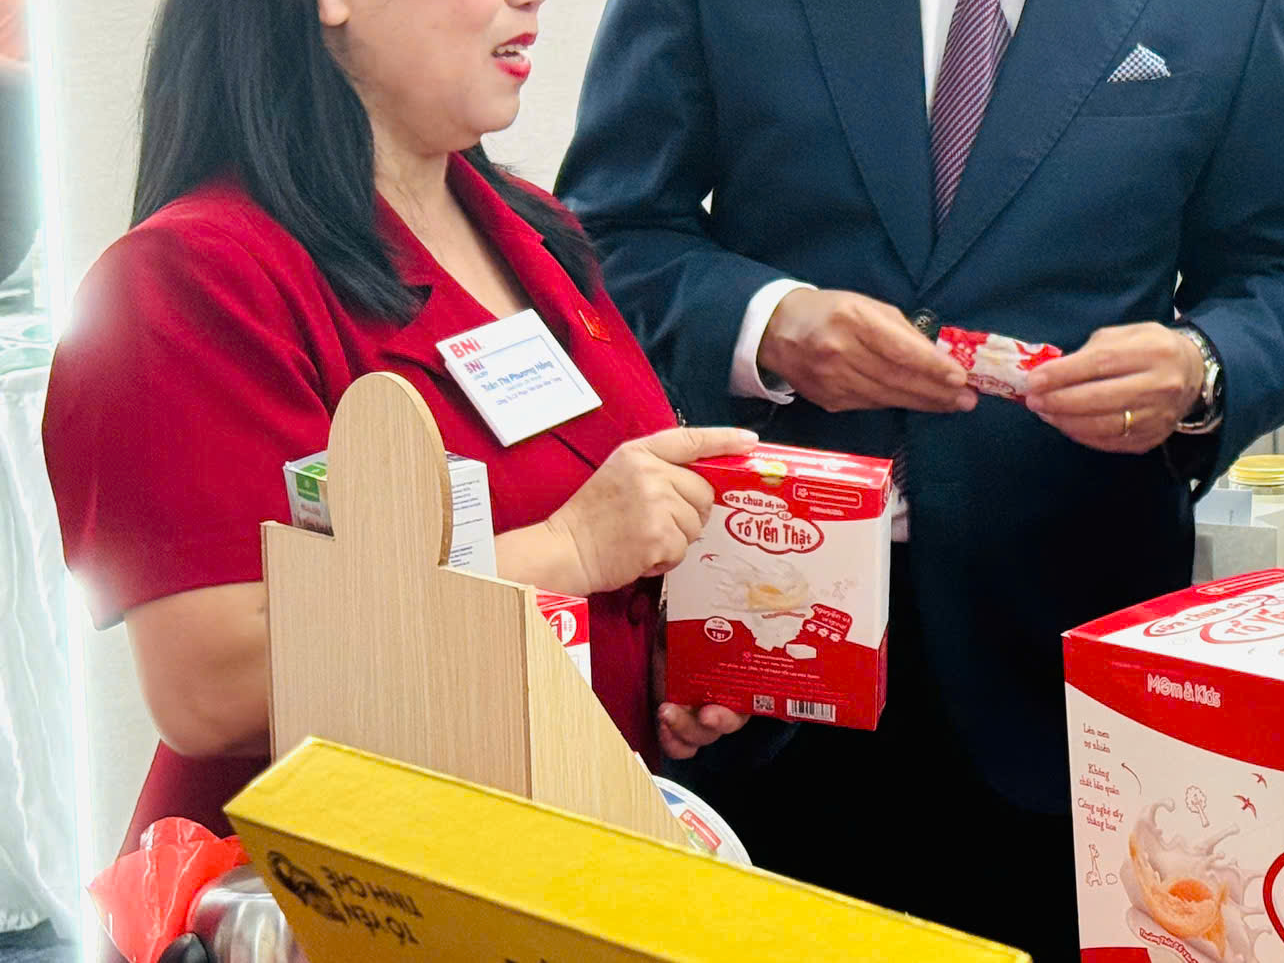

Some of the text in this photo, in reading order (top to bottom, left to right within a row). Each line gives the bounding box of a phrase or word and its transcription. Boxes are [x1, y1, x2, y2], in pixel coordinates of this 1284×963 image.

[755, 517, 778, 544] Yến
[782, 523, 813, 550] Thật
[1195, 684, 1221, 708] Kids
